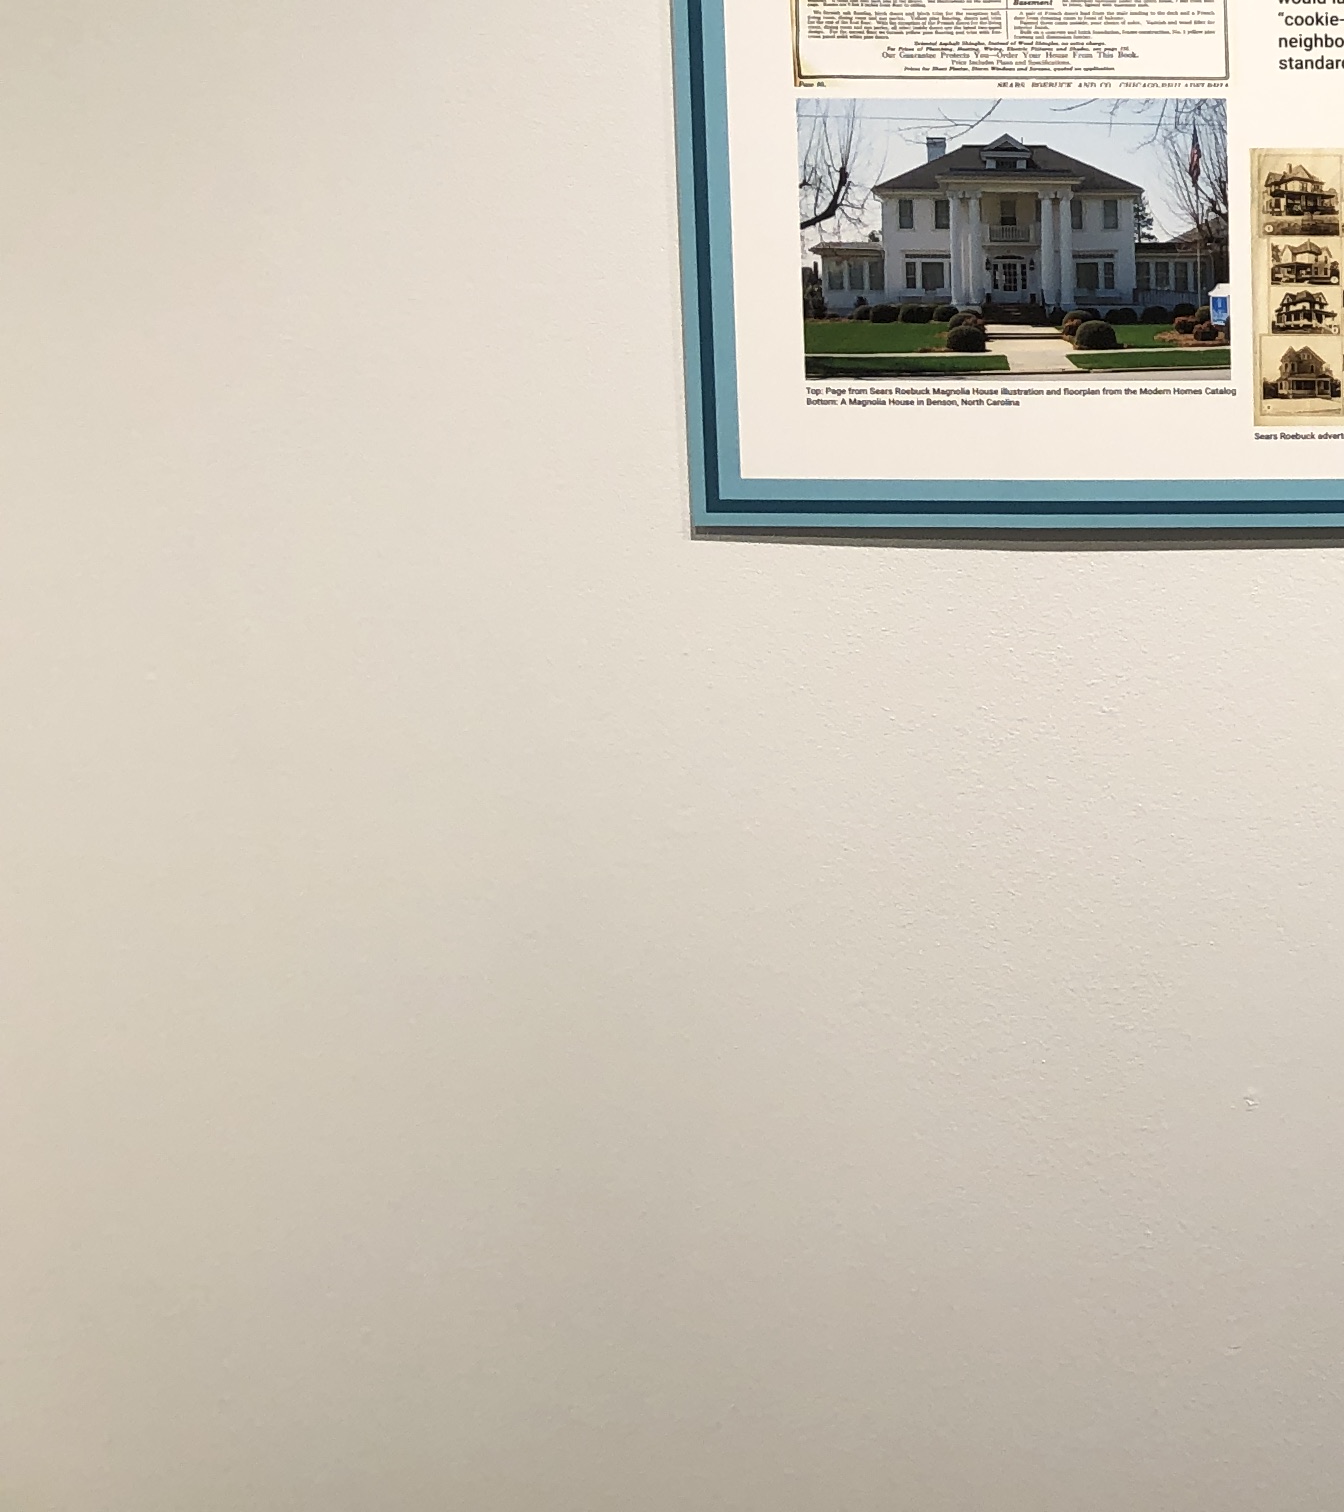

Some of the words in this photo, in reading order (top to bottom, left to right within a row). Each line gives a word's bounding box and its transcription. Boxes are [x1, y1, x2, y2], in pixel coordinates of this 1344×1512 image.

[806, 387, 823, 396] Top:
[825, 387, 846, 396] Page
[848, 387, 868, 395] from
[869, 387, 894, 395] Sears
[895, 387, 931, 395] Roebuck
[932, 387, 970, 397] Magnolia
[1001, 387, 1044, 395] illustration
[1063, 388, 1100, 397] floorplan
[1102, 387, 1122, 395] from
[1139, 387, 1171, 395] Modern
[1173, 387, 1203, 395] Homes
[1205, 387, 1237, 396] Catalog
[849, 398, 886, 407] Magnolia
[888, 398, 915, 406] House
[917, 398, 924, 406] in
[926, 398, 959, 407] Benson,
[961, 398, 984, 406] North
[986, 398, 1020, 406] Carolina
[1280, 432, 1316, 440] Roebuck
